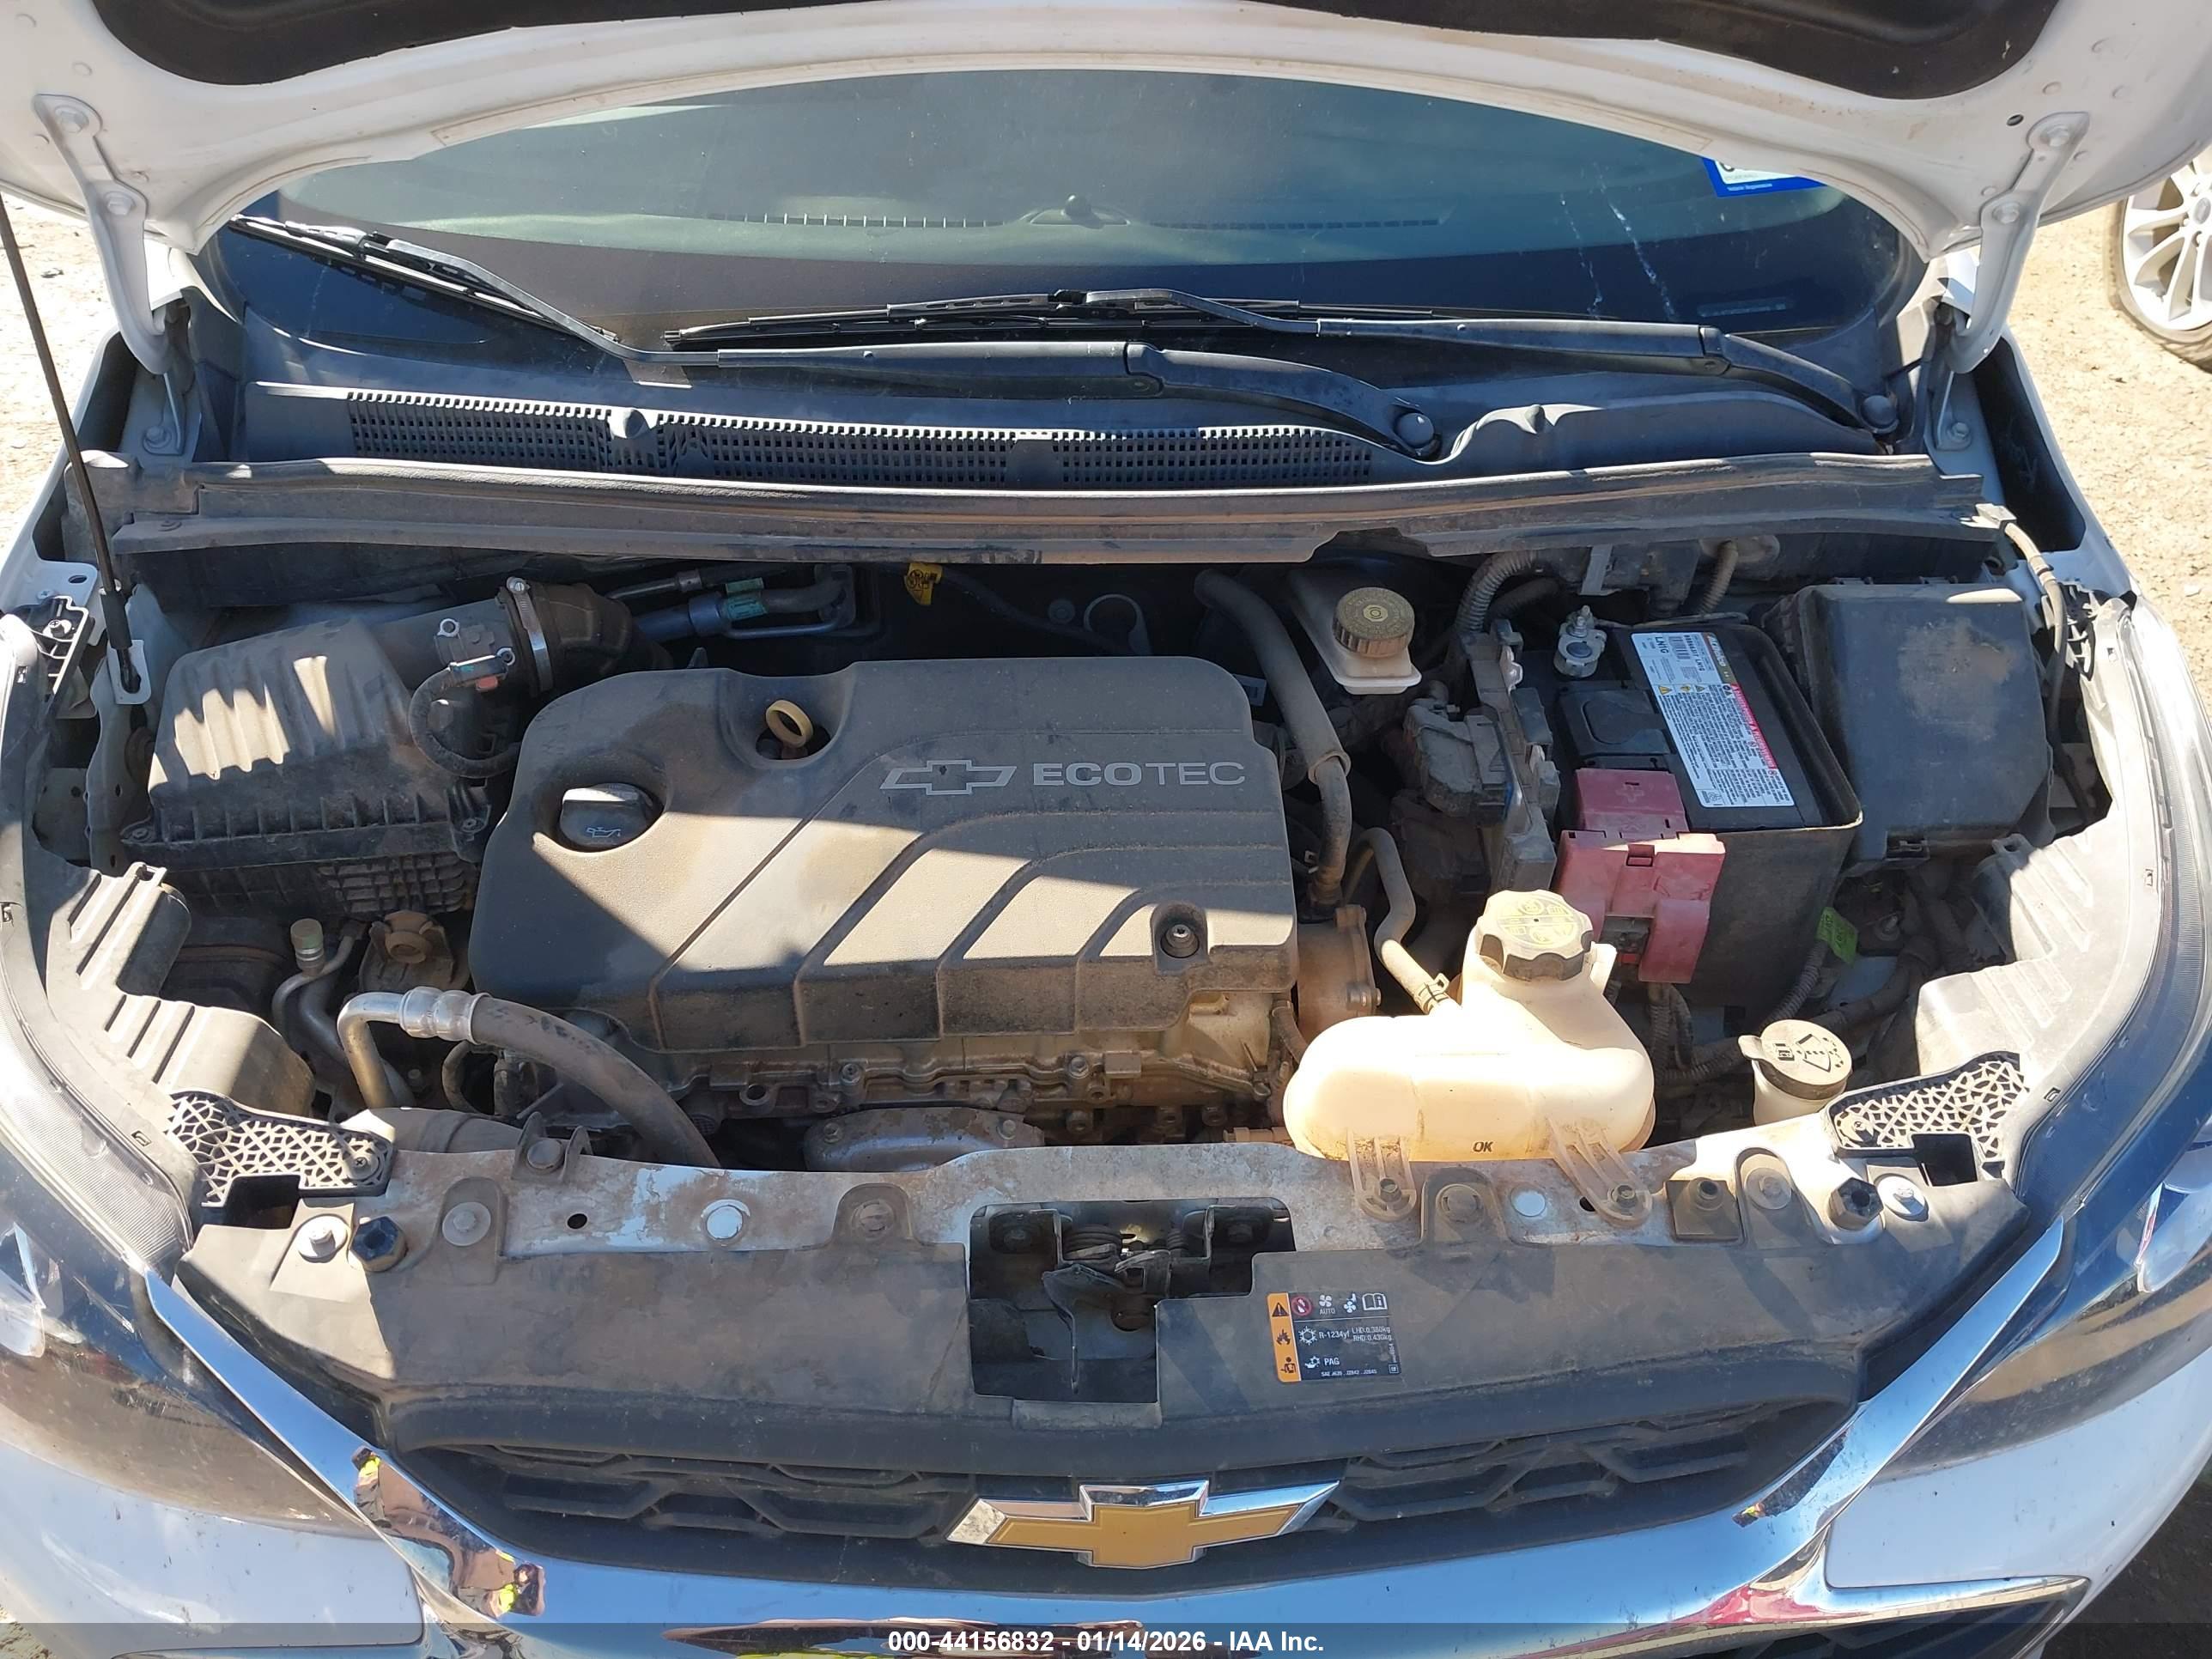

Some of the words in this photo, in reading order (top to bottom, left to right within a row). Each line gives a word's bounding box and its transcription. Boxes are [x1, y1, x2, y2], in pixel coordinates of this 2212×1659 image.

[1655, 636, 1668, 653] LN1G
[1033, 762, 1246, 787] ECOTEC
[1473, 1141, 1494, 1152] OK
[1318, 1330, 1350, 1340] R-1234yf
[1324, 1358, 1340, 1366] PAG
